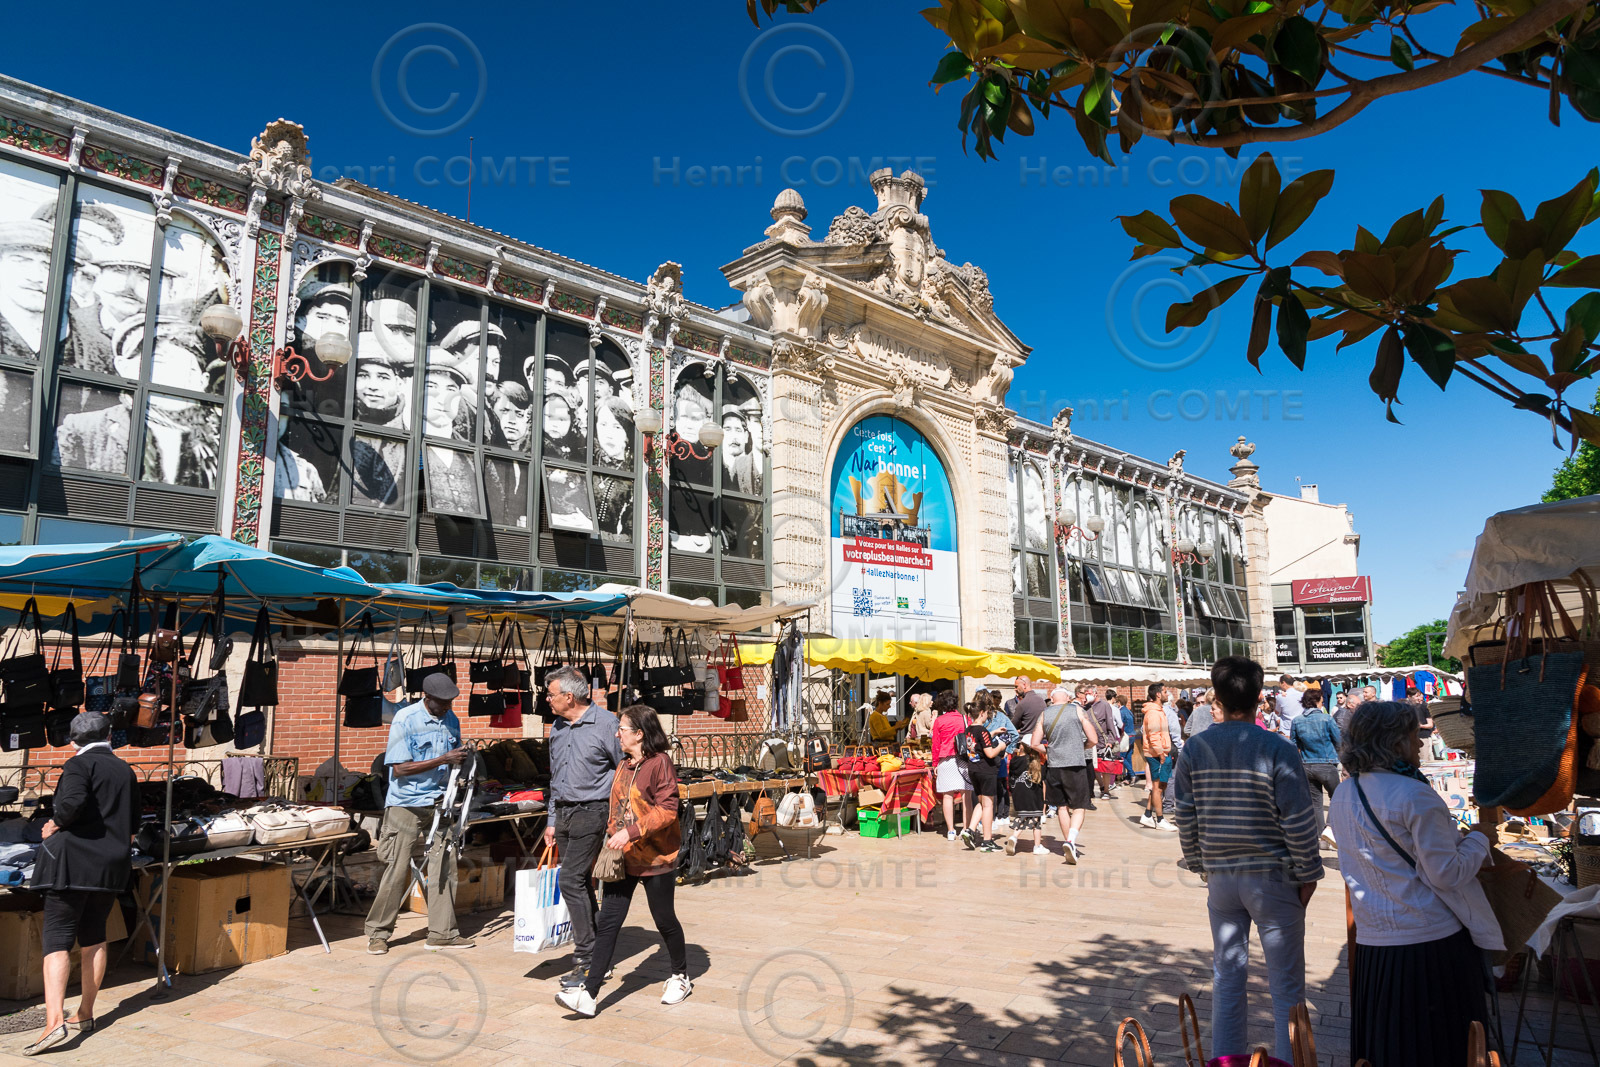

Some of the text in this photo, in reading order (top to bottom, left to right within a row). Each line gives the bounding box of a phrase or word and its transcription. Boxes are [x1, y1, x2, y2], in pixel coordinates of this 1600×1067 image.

[854, 427, 895, 445] Cette fois,
[868, 442, 887, 454] c'est
[852, 449, 920, 479] Narbonne
[858, 540, 874, 549] Votez
[875, 542, 887, 550] pour
[887, 543, 895, 551] les
[845, 550, 931, 567] votreplusbeaumarche.fr
[1329, 595, 1363, 603] Restaurant
